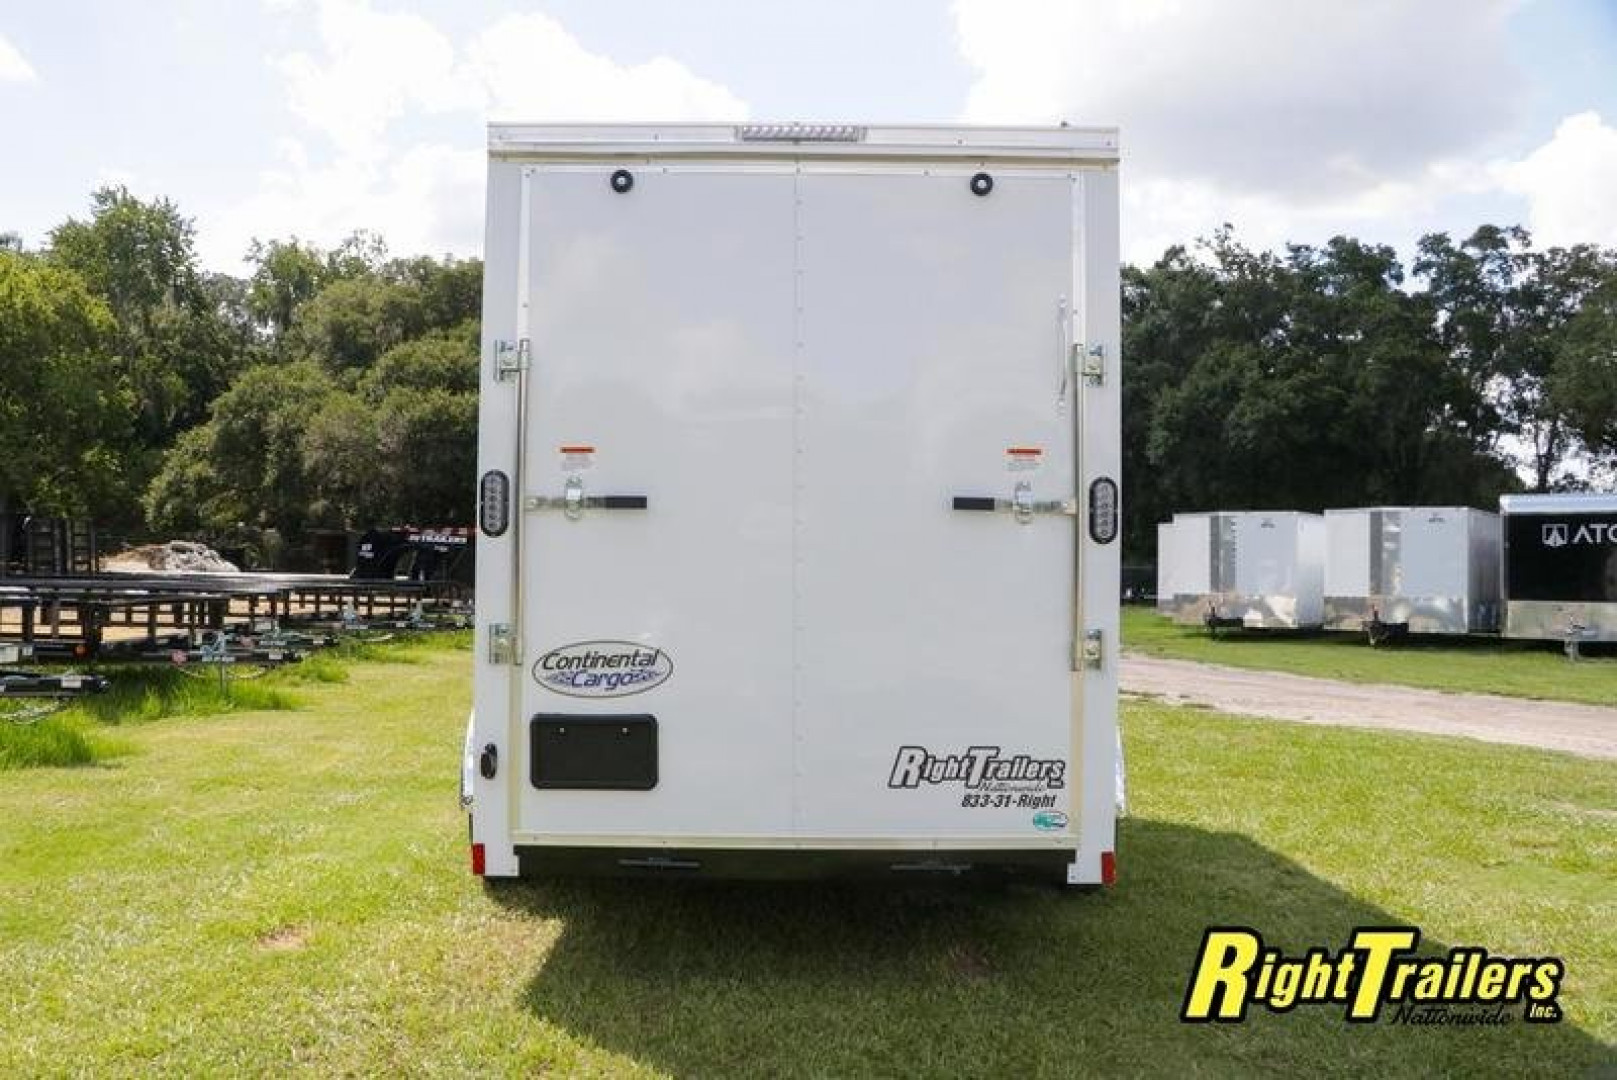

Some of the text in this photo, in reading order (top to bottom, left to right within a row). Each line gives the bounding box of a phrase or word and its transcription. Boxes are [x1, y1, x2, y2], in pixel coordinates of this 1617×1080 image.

[543, 649, 660, 670] Continental
[571, 671, 634, 690] Cargo
[962, 794, 1057, 809] 833-31-Right
